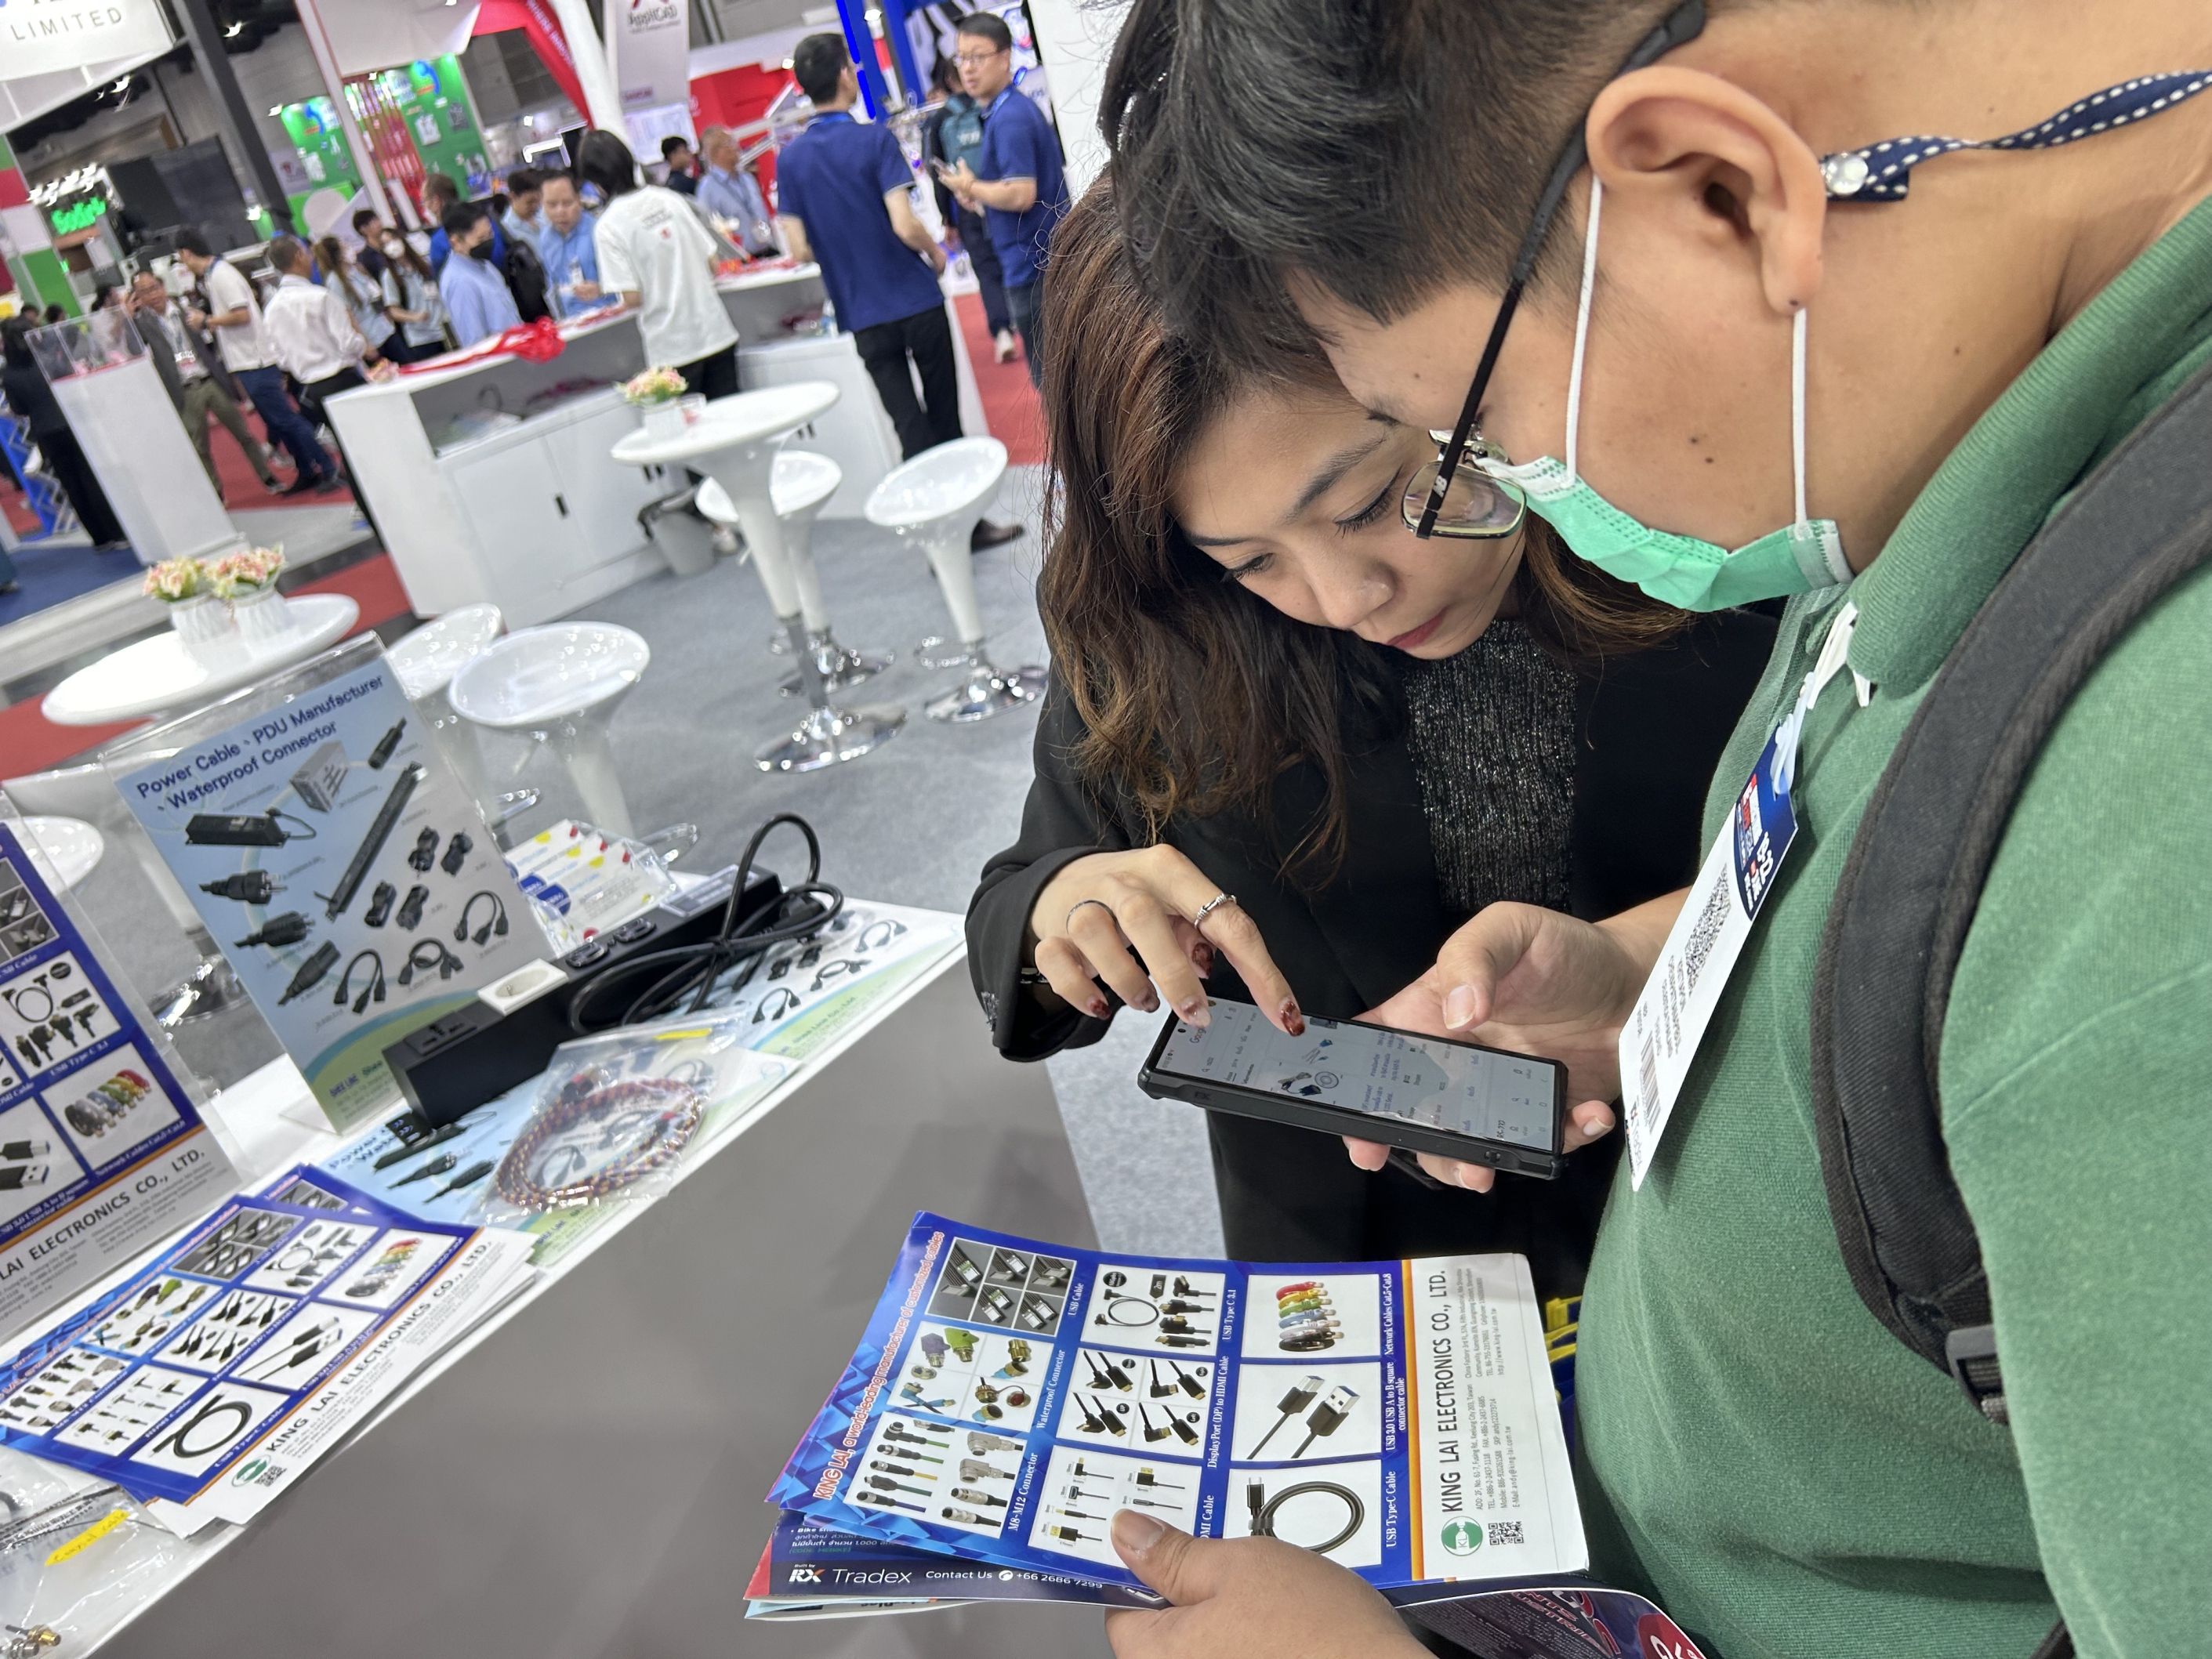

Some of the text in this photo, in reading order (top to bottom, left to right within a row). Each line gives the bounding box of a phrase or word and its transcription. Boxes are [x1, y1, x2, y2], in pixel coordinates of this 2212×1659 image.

[10, 6, 122, 41] LIMITED
[136, 674, 386, 799] Power Cable PDU Manufacturer
[167, 757, 262, 810] Waterproof
[261, 720, 338, 766] Connector
[1188, 1027, 1206, 1044] Goog
[0, 1149, 205, 1281] LAI ELECTRONICS CO., LTD.
[1153, 1280, 1162, 1289] 2m
[1226, 1289, 1236, 1299] 3.1
[1068, 1282, 1085, 1317] USB Cable
[1224, 1306, 1235, 1324] Type
[1383, 1306, 1393, 1326] Cables
[1221, 1325, 1232, 1339] USB
[1383, 1327, 1394, 1354] Network
[265, 1416, 308, 1454] KING
[310, 1389, 338, 1412] LAI
[339, 1301, 432, 1386] ELECTRONICS
[459, 1239, 493, 1268] LTD.
[812, 1467, 843, 1500] KING
[830, 1446, 854, 1470] LAI,
[850, 1376, 887, 1437] world-leading
[877, 1317, 908, 1376] manufacturer
[906, 1260, 933, 1307] customized
[926, 1230, 945, 1259] cables
[1217, 1356, 1229, 1375] Cable
[1385, 1361, 1396, 1382] square
[1036, 1349, 1066, 1429] Waterproof Connector
[1215, 1375, 1227, 1396] HDMI
[1428, 1270, 1463, 1512] KING LAI ELECTRONICS CO., LTD.
[1212, 1407, 1224, 1422] (DP)
[1384, 1406, 1394, 1422] USB
[1395, 1377, 1406, 1429] connector cable
[1385, 1423, 1395, 1433] 3.0
[1207, 1423, 1223, 1468] DisplayPort
[1384, 1434, 1395, 1450] USB
[1020, 1452, 1039, 1495] Connector
[1202, 1494, 1214, 1520] Cable
[1385, 1470, 1398, 1547] USB Type-C Cable
[832, 1564, 912, 1586] Tradex
[925, 1568, 974, 1581] Contact
[977, 1570, 993, 1581] Us
[1016, 1571, 1038, 1581] +66
[1041, 1574, 1071, 1585] 2686
[1074, 1578, 1102, 1588] 7299
